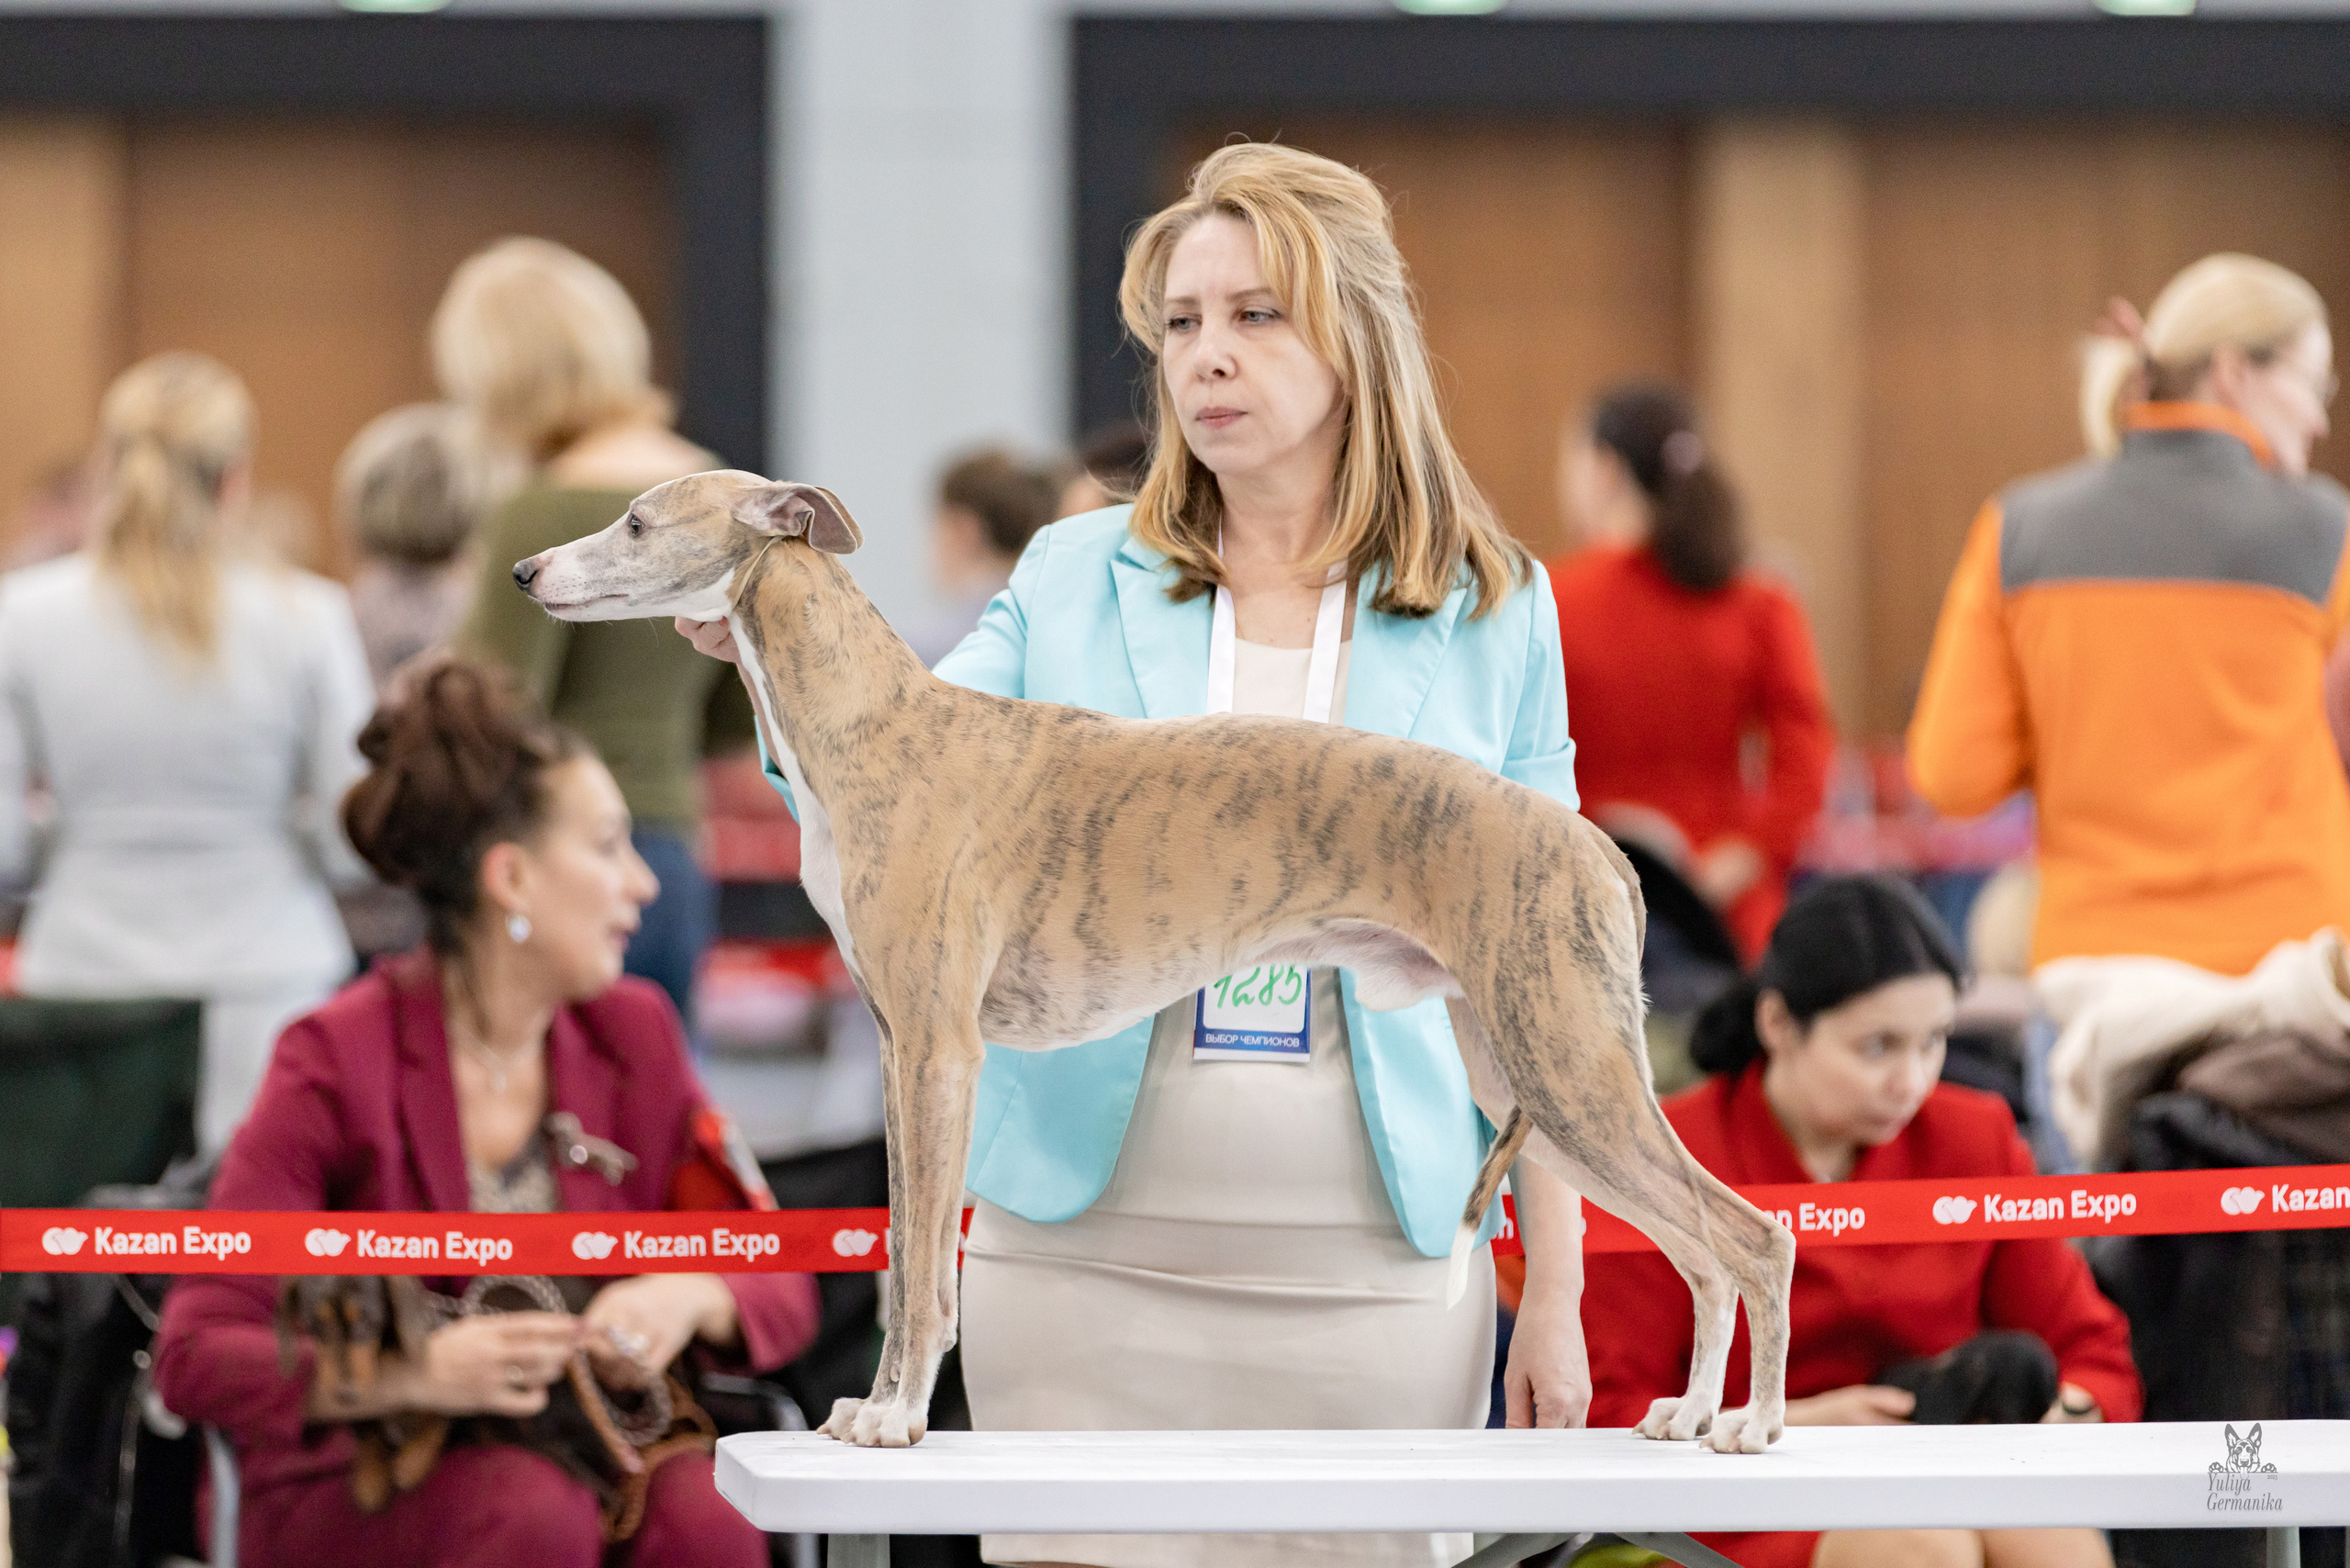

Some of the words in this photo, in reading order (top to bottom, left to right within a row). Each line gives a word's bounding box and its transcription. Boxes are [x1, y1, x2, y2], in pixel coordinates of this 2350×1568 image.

[1214, 965, 1302, 1009] 1285
[1204, 1033, 1239, 1045] ВЫБОР
[1239, 1035, 1301, 1047] ЧЕМПИОНОВ
[1983, 1193, 2065, 1223] Kazan
[2070, 1189, 2138, 1224] Expo
[2271, 1182, 2350, 1214] Kazan
[1797, 1202, 1866, 1238] Expo
[95, 1226, 177, 1255] Kazan
[183, 1226, 252, 1261] Expo
[356, 1228, 440, 1260] Kazan
[445, 1231, 513, 1267] Expo
[623, 1230, 707, 1259] Kazan
[712, 1227, 780, 1262] Expo
